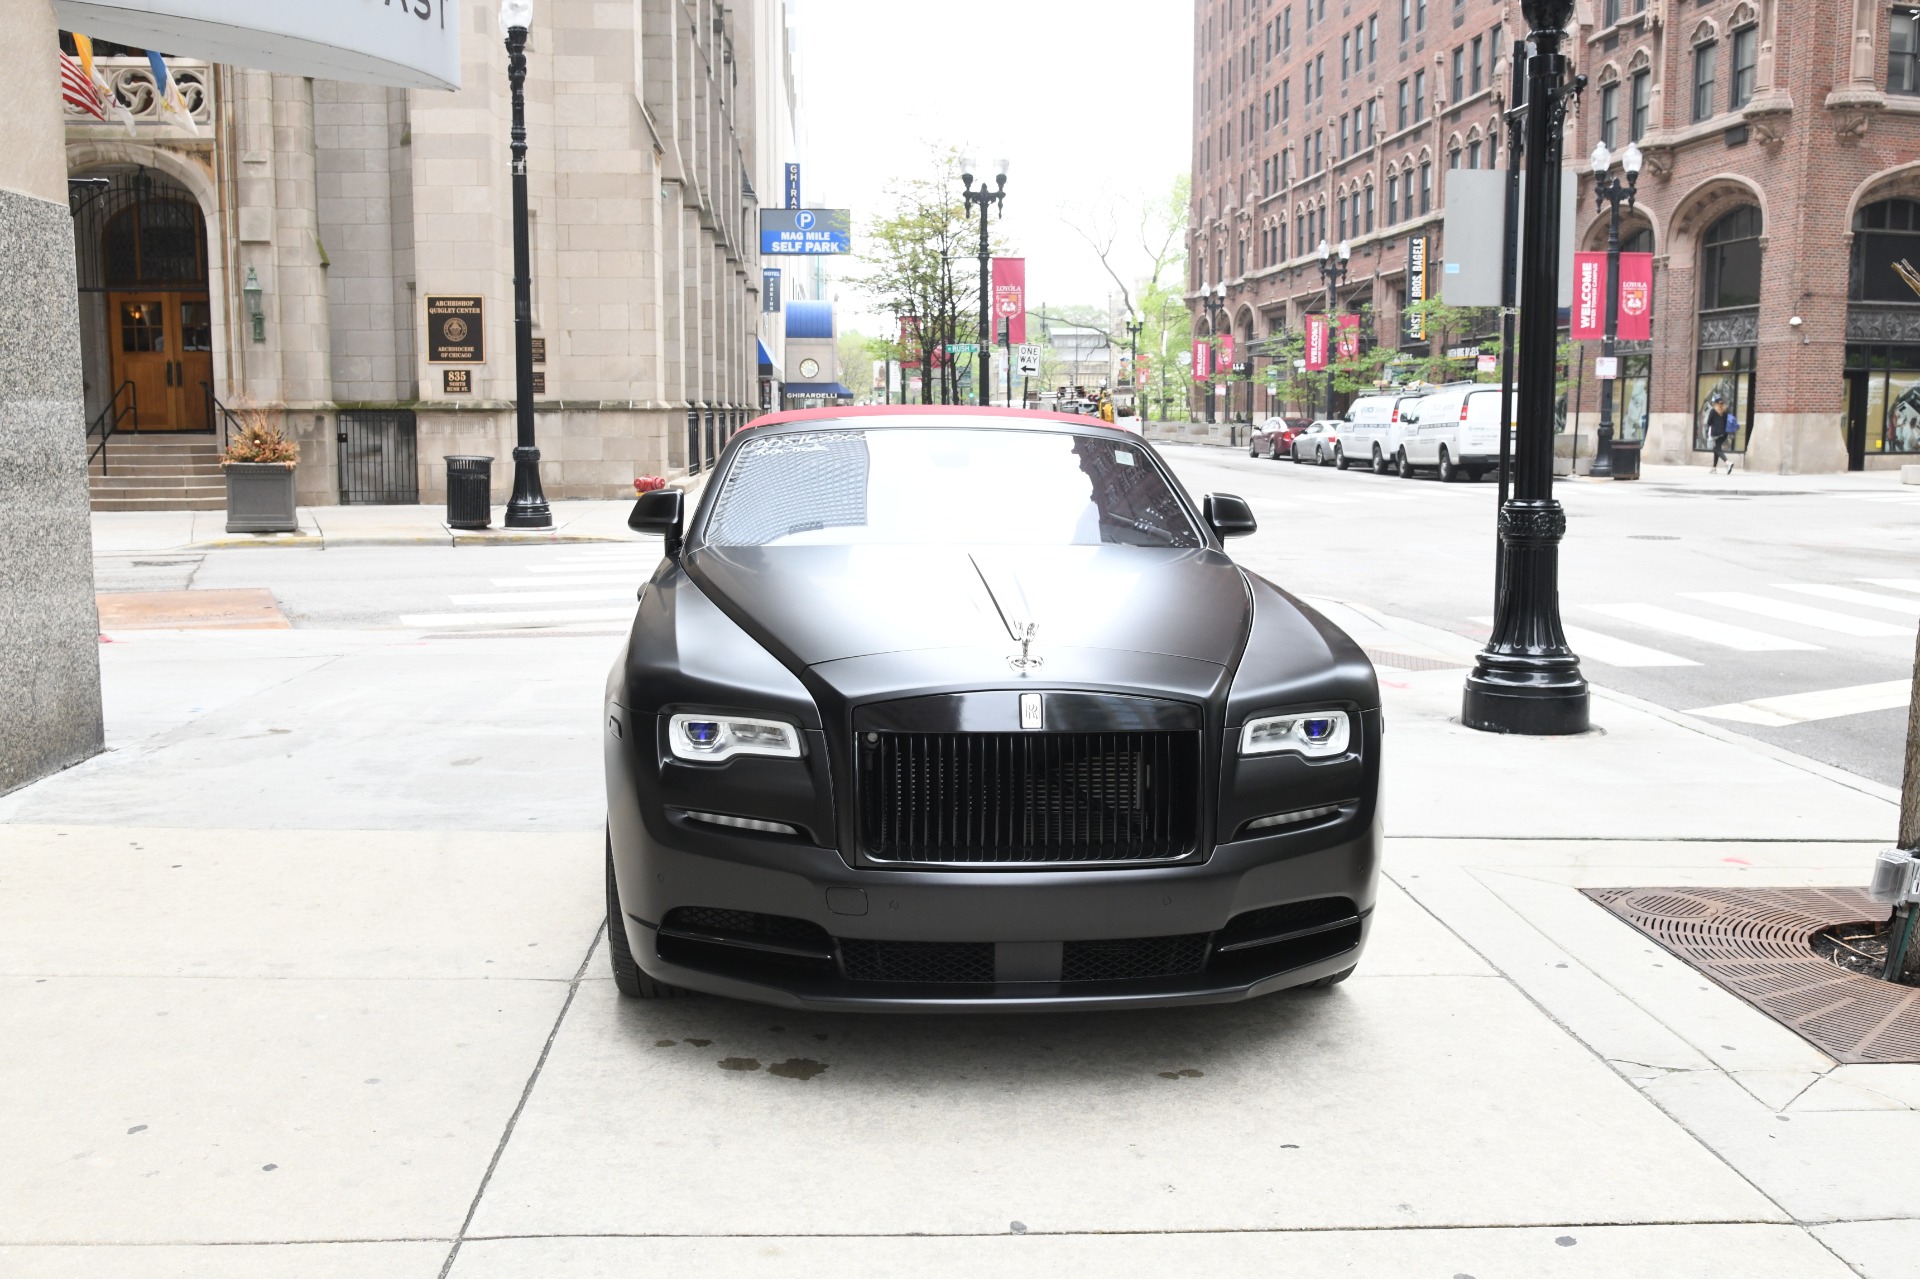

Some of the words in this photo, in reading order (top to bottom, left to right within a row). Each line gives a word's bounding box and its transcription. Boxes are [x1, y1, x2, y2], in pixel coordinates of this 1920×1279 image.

[800, 213, 812, 227] P
[781, 232, 804, 241] MAG
[806, 232, 831, 241] MILE
[772, 241, 803, 252] SELF
[805, 241, 840, 252] PARK
[1412, 238, 1423, 272] BAGELS
[1580, 262, 1593, 329] WELCOME
[1311, 321, 1319, 364] WELCOME
[1020, 347, 1038, 356] ONE
[1020, 355, 1037, 364] WAY
[448, 371, 467, 380] 835
